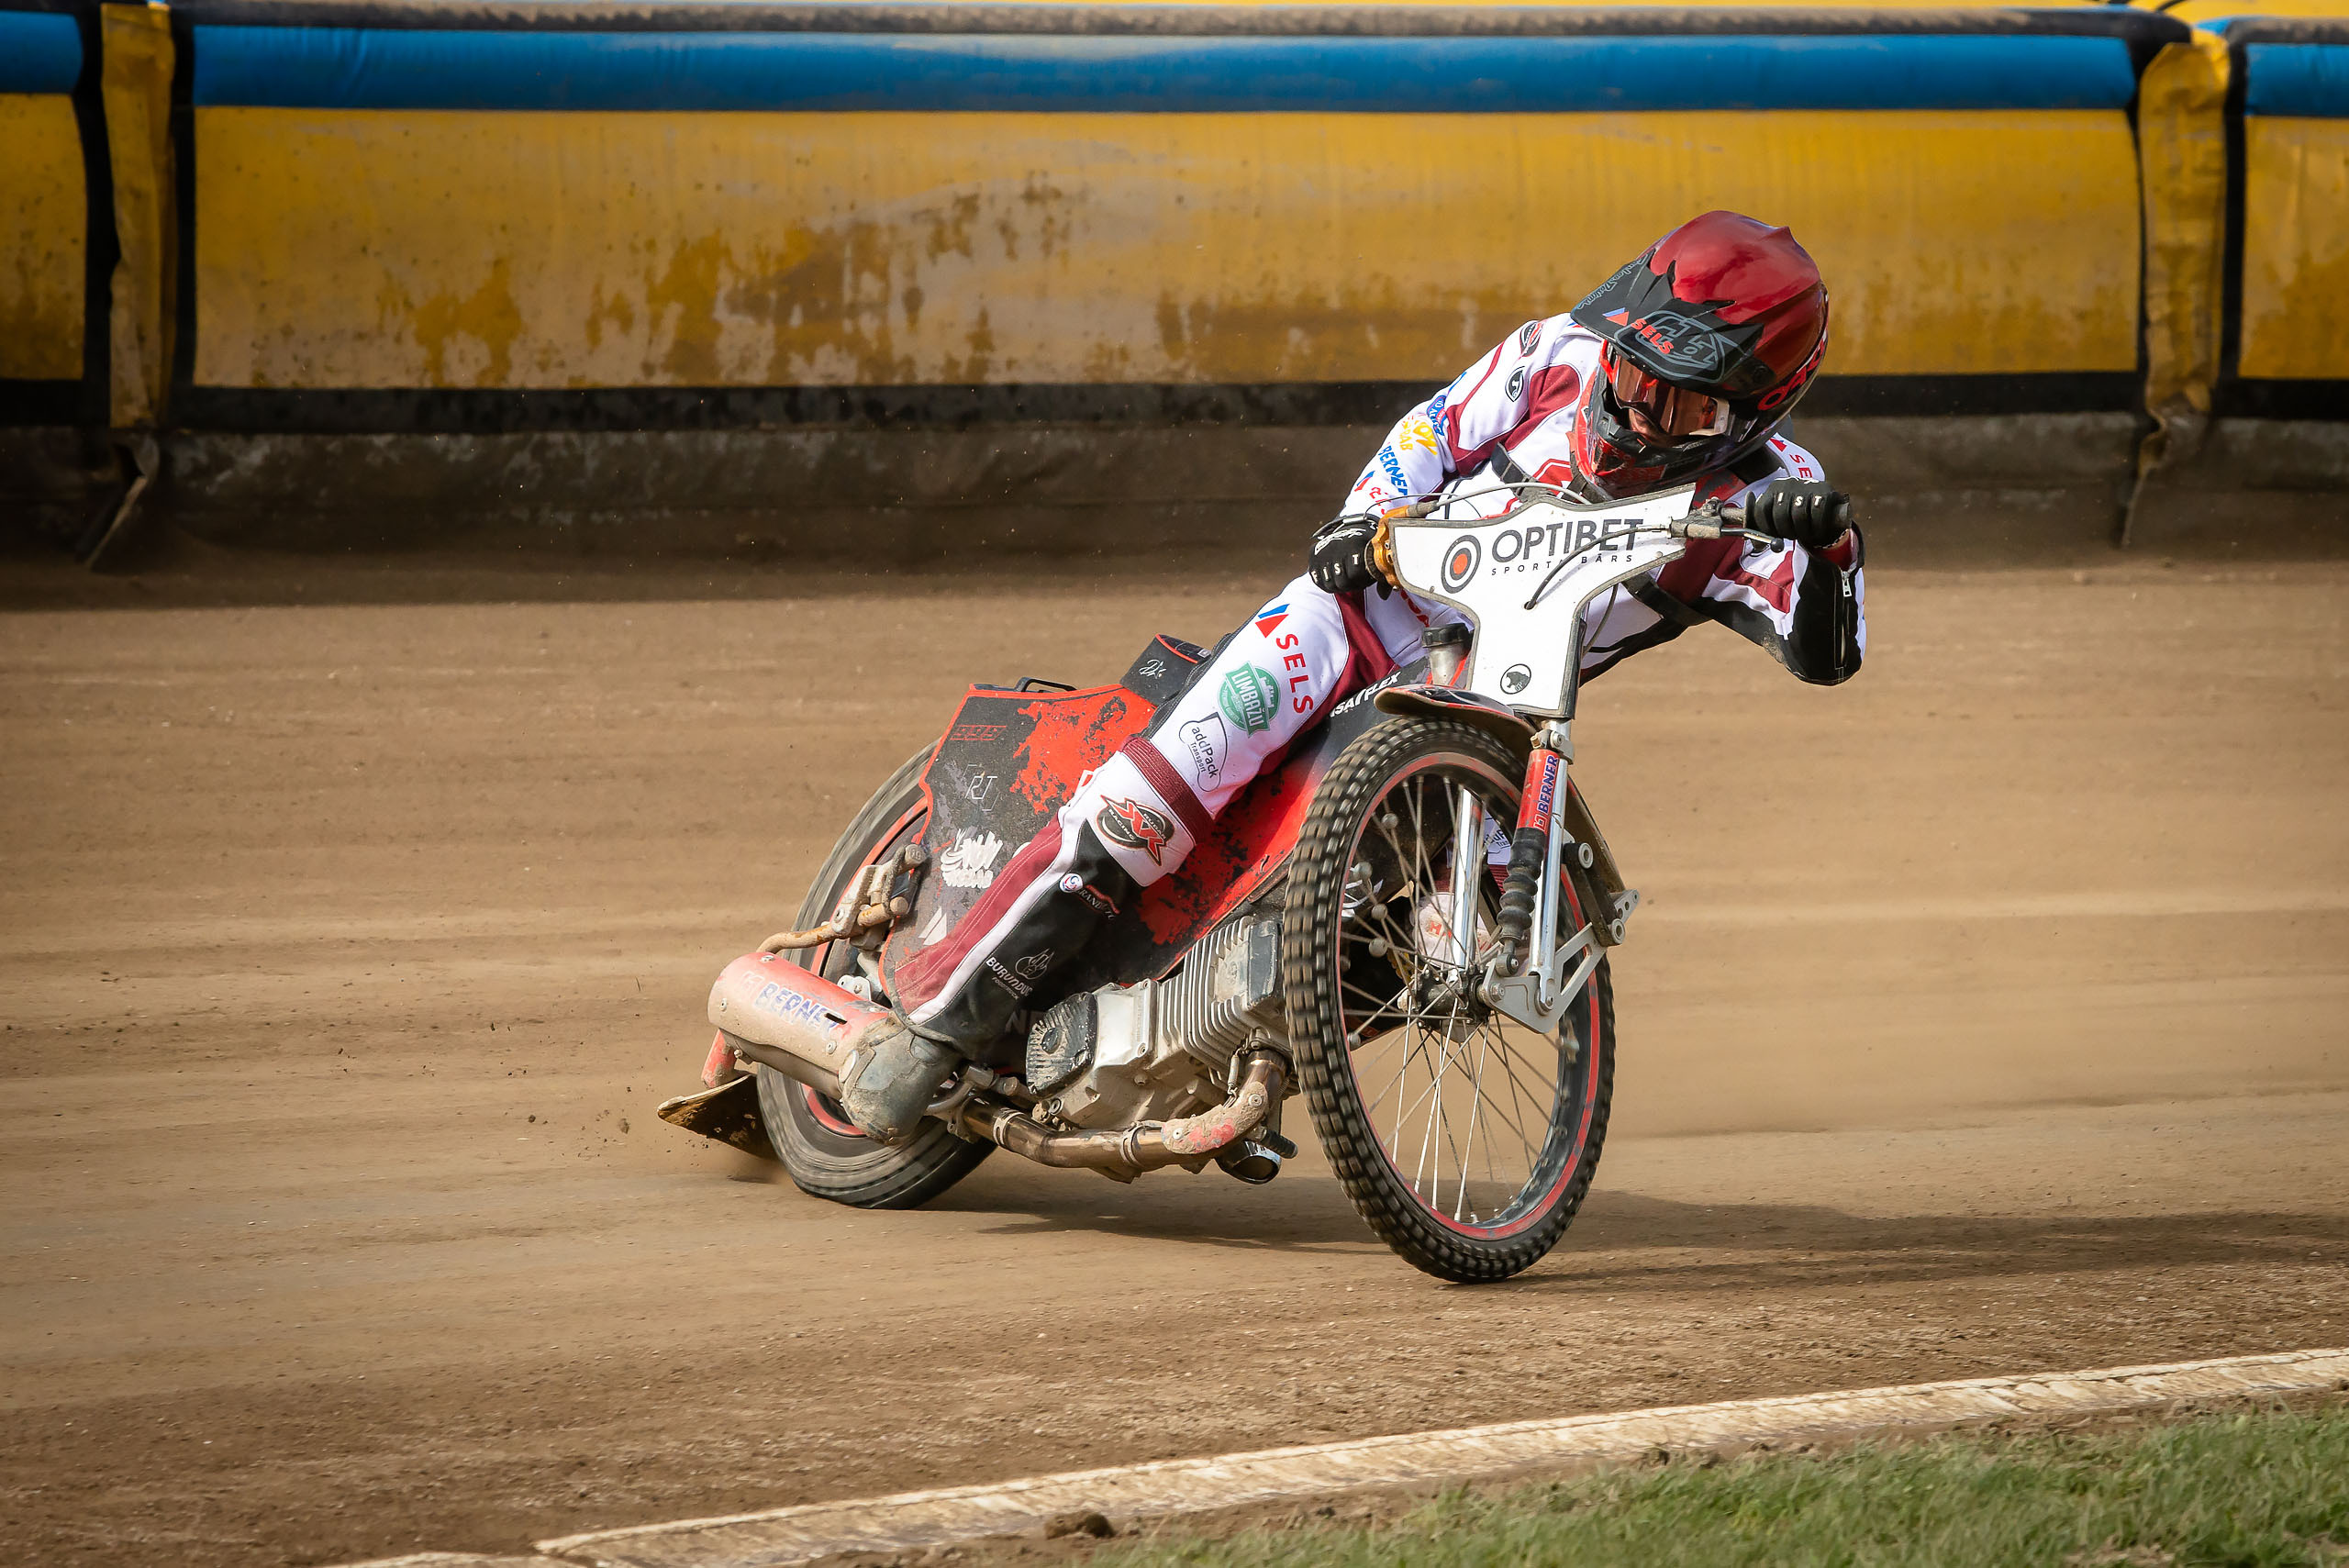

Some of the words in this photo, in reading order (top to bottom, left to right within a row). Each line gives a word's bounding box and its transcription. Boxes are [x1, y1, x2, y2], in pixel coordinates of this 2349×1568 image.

[1631, 318, 1675, 355] SELS
[1492, 518, 1644, 563] OPTIBET
[1491, 559, 1563, 576] SPORT
[1581, 553, 1632, 564] BĀRS
[1275, 633, 1314, 714] SELS
[1230, 670, 1265, 727] LIMBAŽU
[1190, 741, 1207, 773] Transport
[1191, 727, 1219, 779] addPack
[1537, 754, 1559, 815] BERNER
[1108, 808, 1136, 840] RACING
